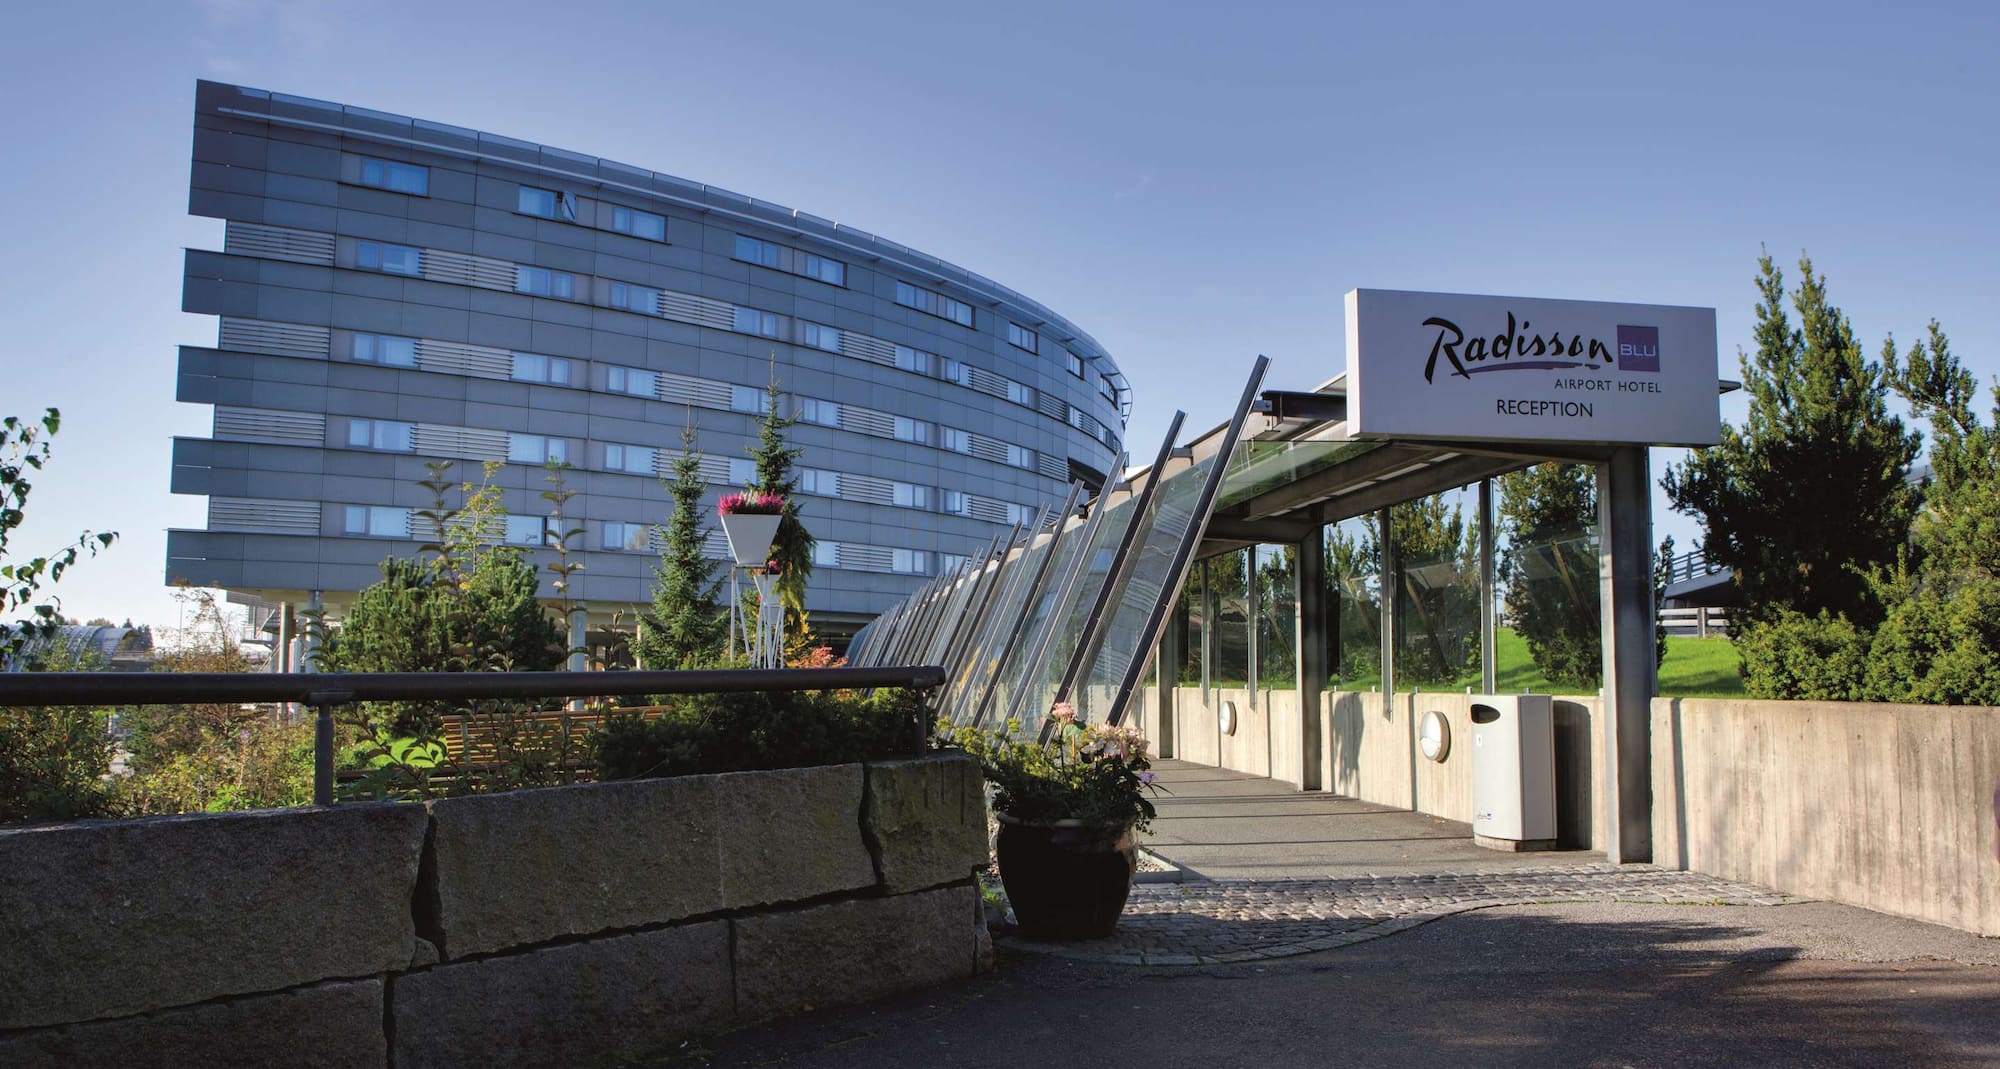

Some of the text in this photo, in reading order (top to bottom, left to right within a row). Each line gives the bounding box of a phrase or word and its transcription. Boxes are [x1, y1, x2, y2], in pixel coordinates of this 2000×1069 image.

[1422, 311, 1656, 385] Radisson BLU
[1554, 378, 1662, 393] AIRPORT HOTEL
[1497, 399, 1593, 417] RECEPTION
